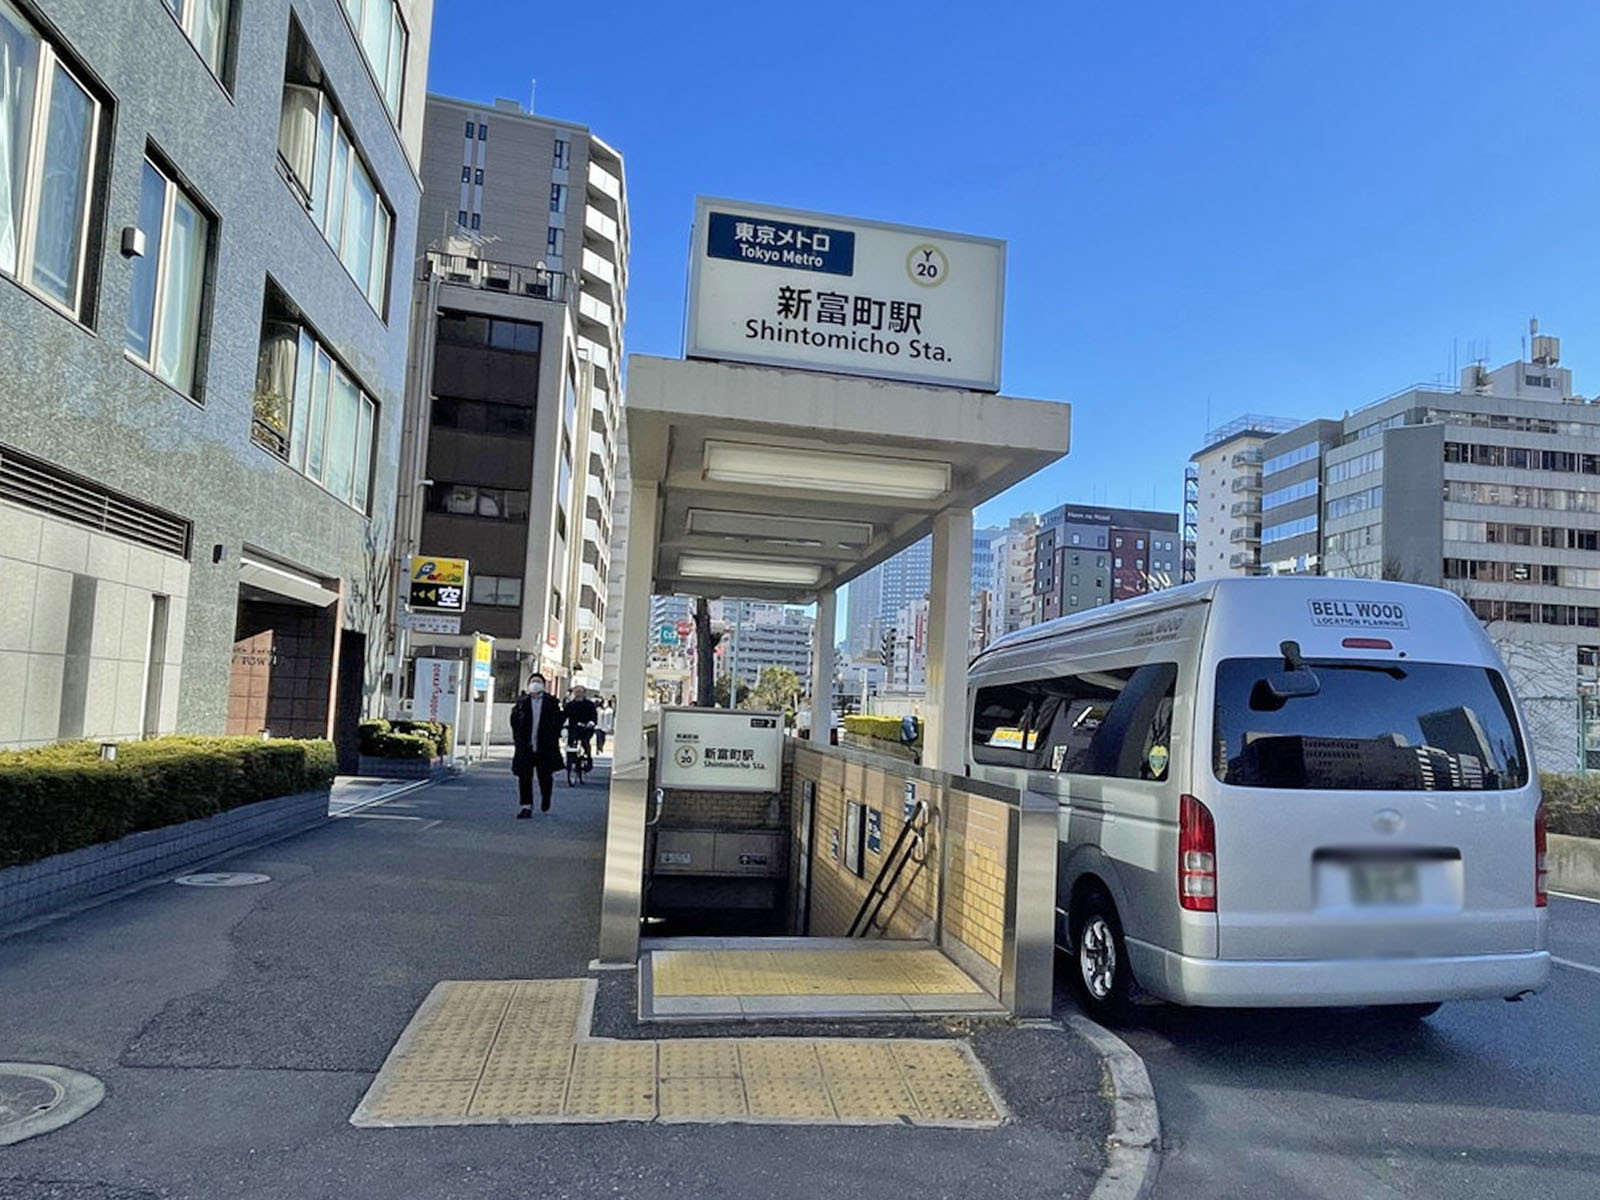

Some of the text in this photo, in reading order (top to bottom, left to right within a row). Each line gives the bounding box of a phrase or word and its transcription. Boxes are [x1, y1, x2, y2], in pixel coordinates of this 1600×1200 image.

[734, 222, 830, 252] 東京メトロ
[739, 243, 823, 267] Tokyo Metro
[923, 250, 933, 262] Y
[917, 263, 938, 278] 20
[776, 285, 922, 336] 新富町駅
[745, 319, 952, 362] Shintomicho Sta.
[438, 587, 461, 608] 空
[1312, 602, 1403, 620] BELL WOOD
[1317, 617, 1404, 628] LOCATION PLANNING
[681, 756, 693, 764] 20
[704, 748, 754, 761] 新富町駅
